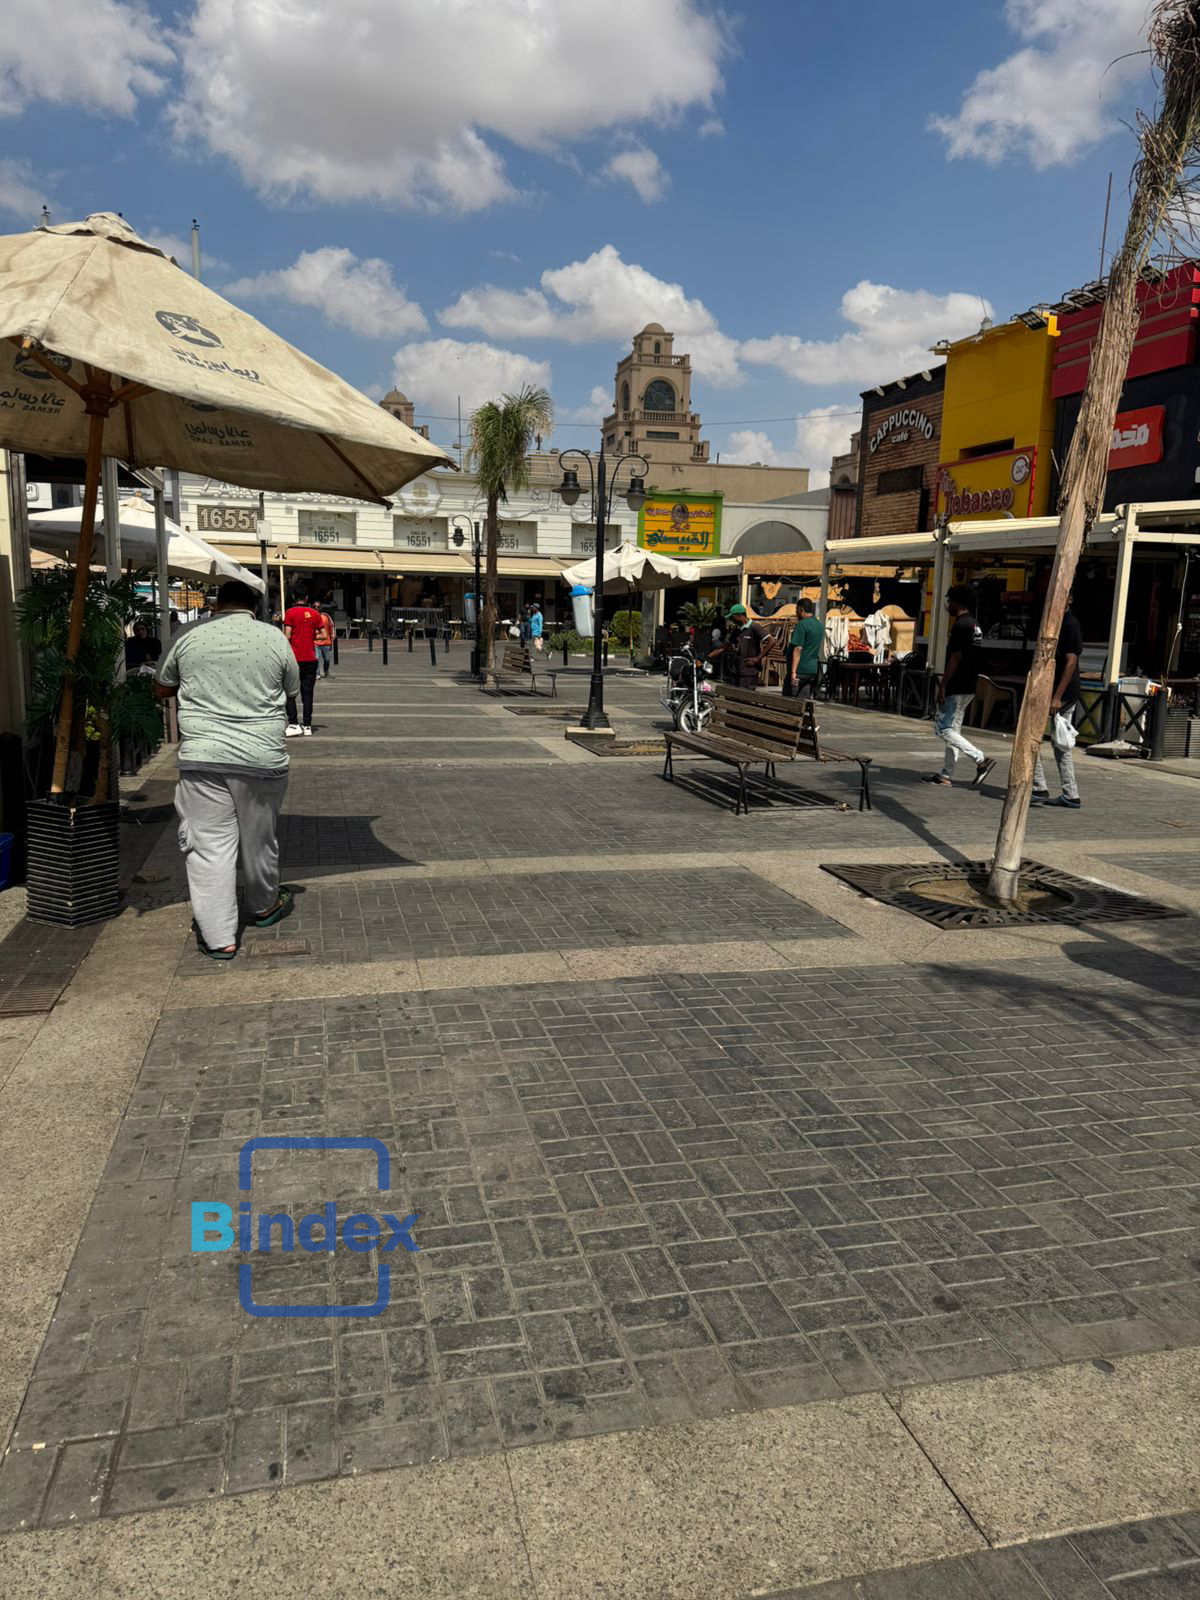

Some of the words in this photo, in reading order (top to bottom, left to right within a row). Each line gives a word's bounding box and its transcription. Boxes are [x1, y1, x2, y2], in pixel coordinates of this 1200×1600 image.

[870, 409, 933, 453] CAPPUCCINO
[944, 487, 1014, 515] Tobacco
[200, 508, 257, 529] 16551
[314, 530, 339, 543] 16551
[407, 535, 431, 547] 16551
